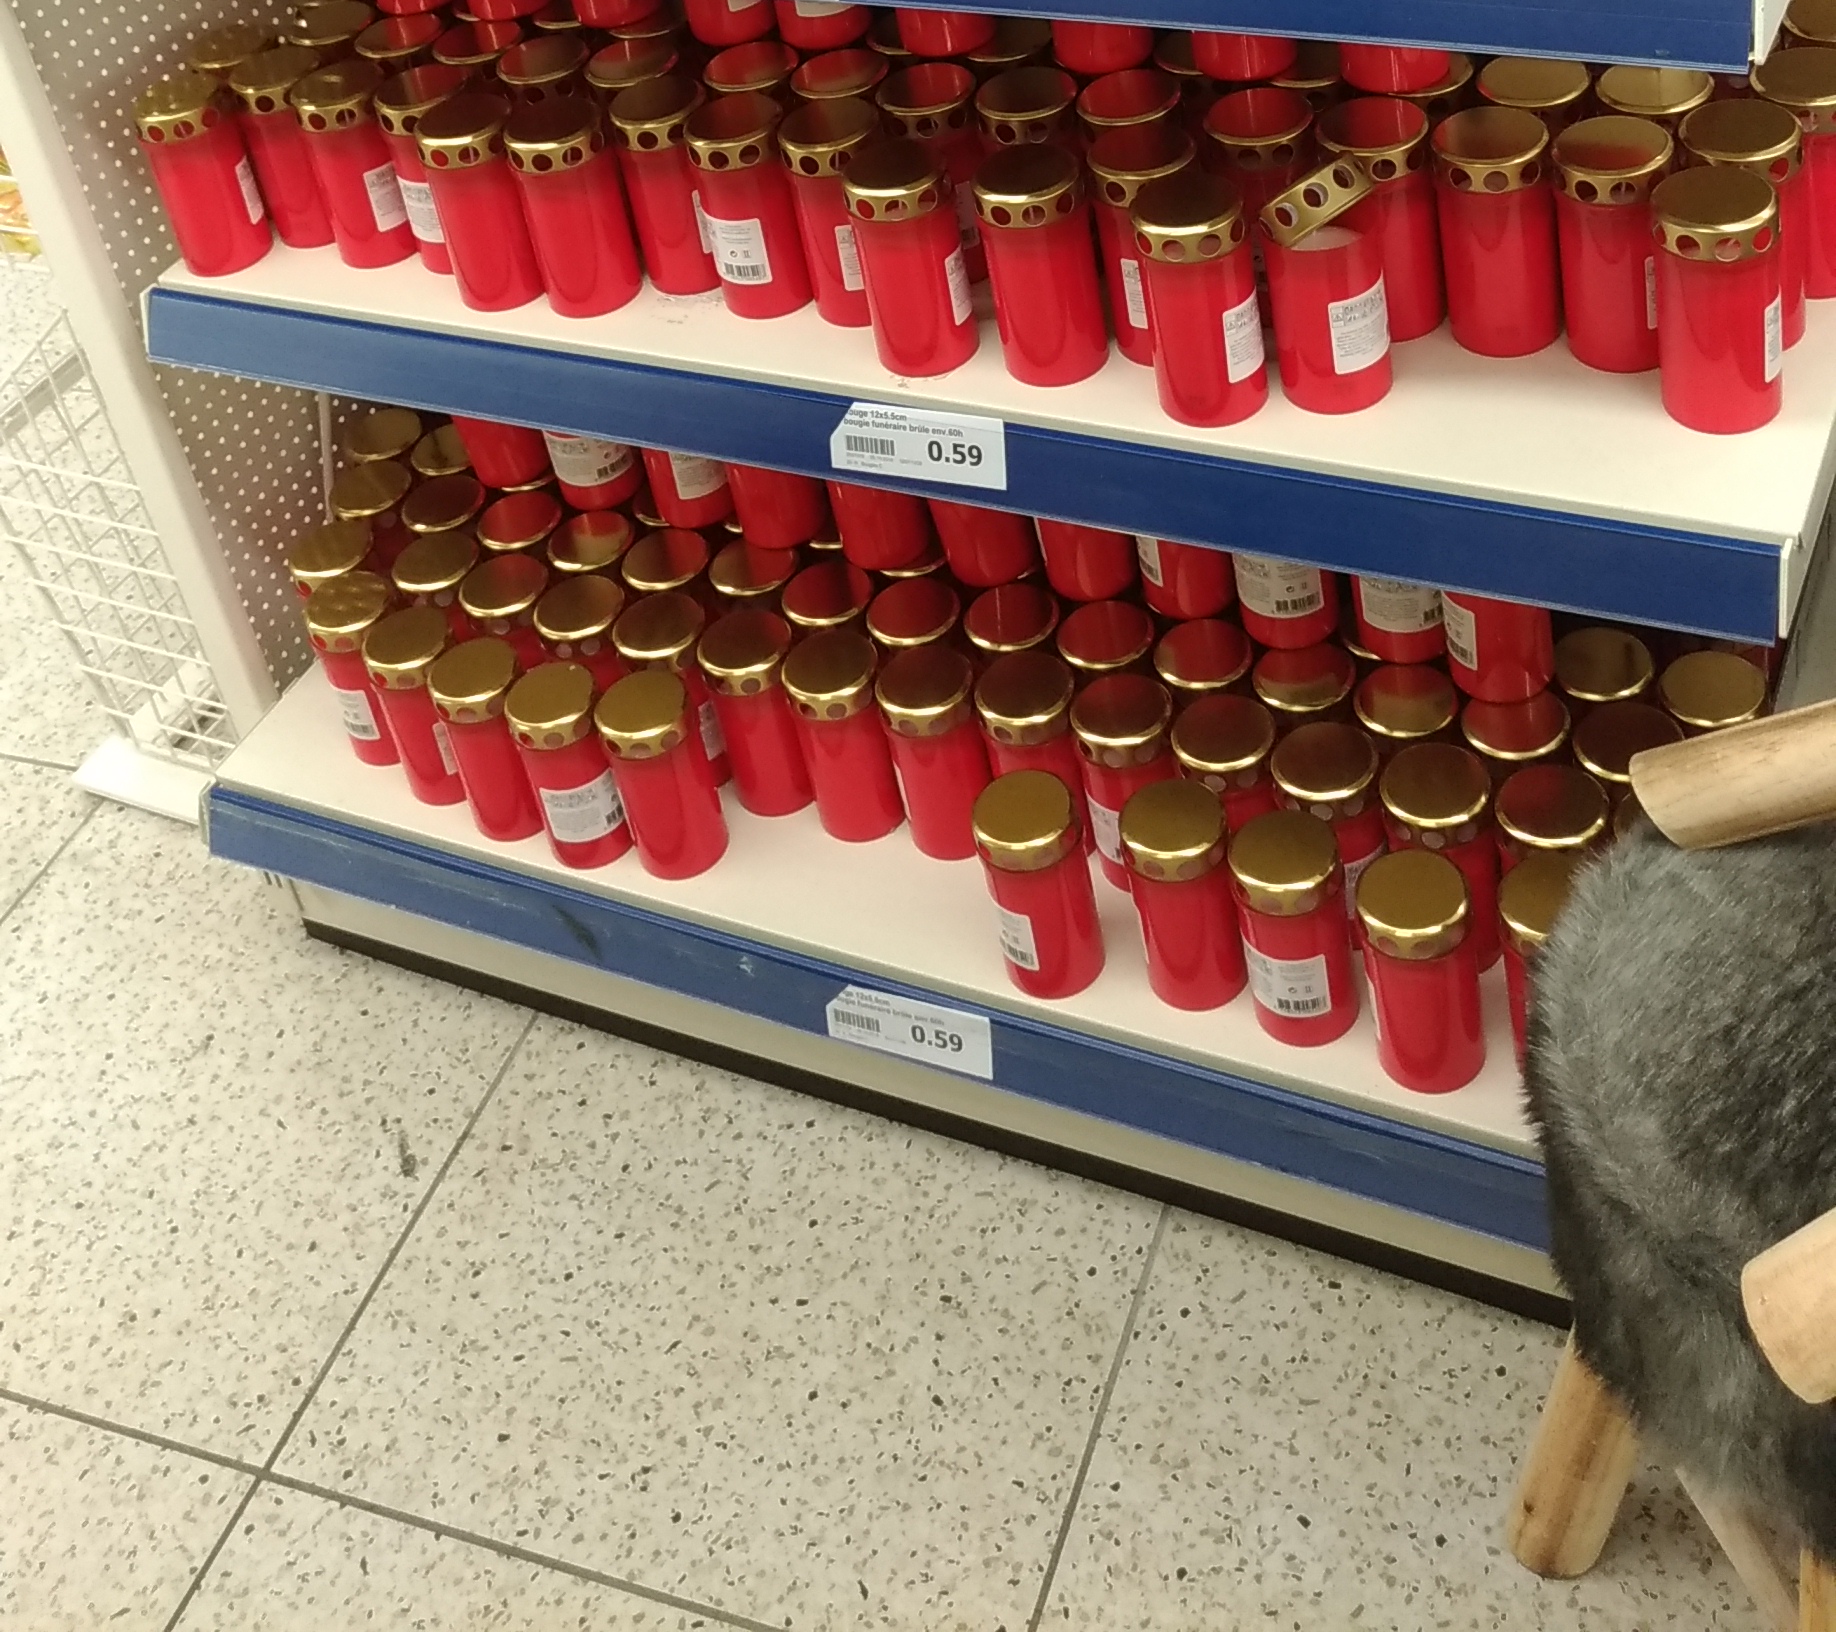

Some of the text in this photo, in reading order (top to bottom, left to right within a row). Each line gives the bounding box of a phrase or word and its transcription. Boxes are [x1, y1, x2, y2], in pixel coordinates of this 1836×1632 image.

[848, 409, 907, 421] ouge 12x5.5cm
[871, 420, 907, 431] funéraire
[909, 424, 930, 434] brûle
[927, 440, 983, 467] 0.59
[911, 1024, 963, 1052] 0.59
